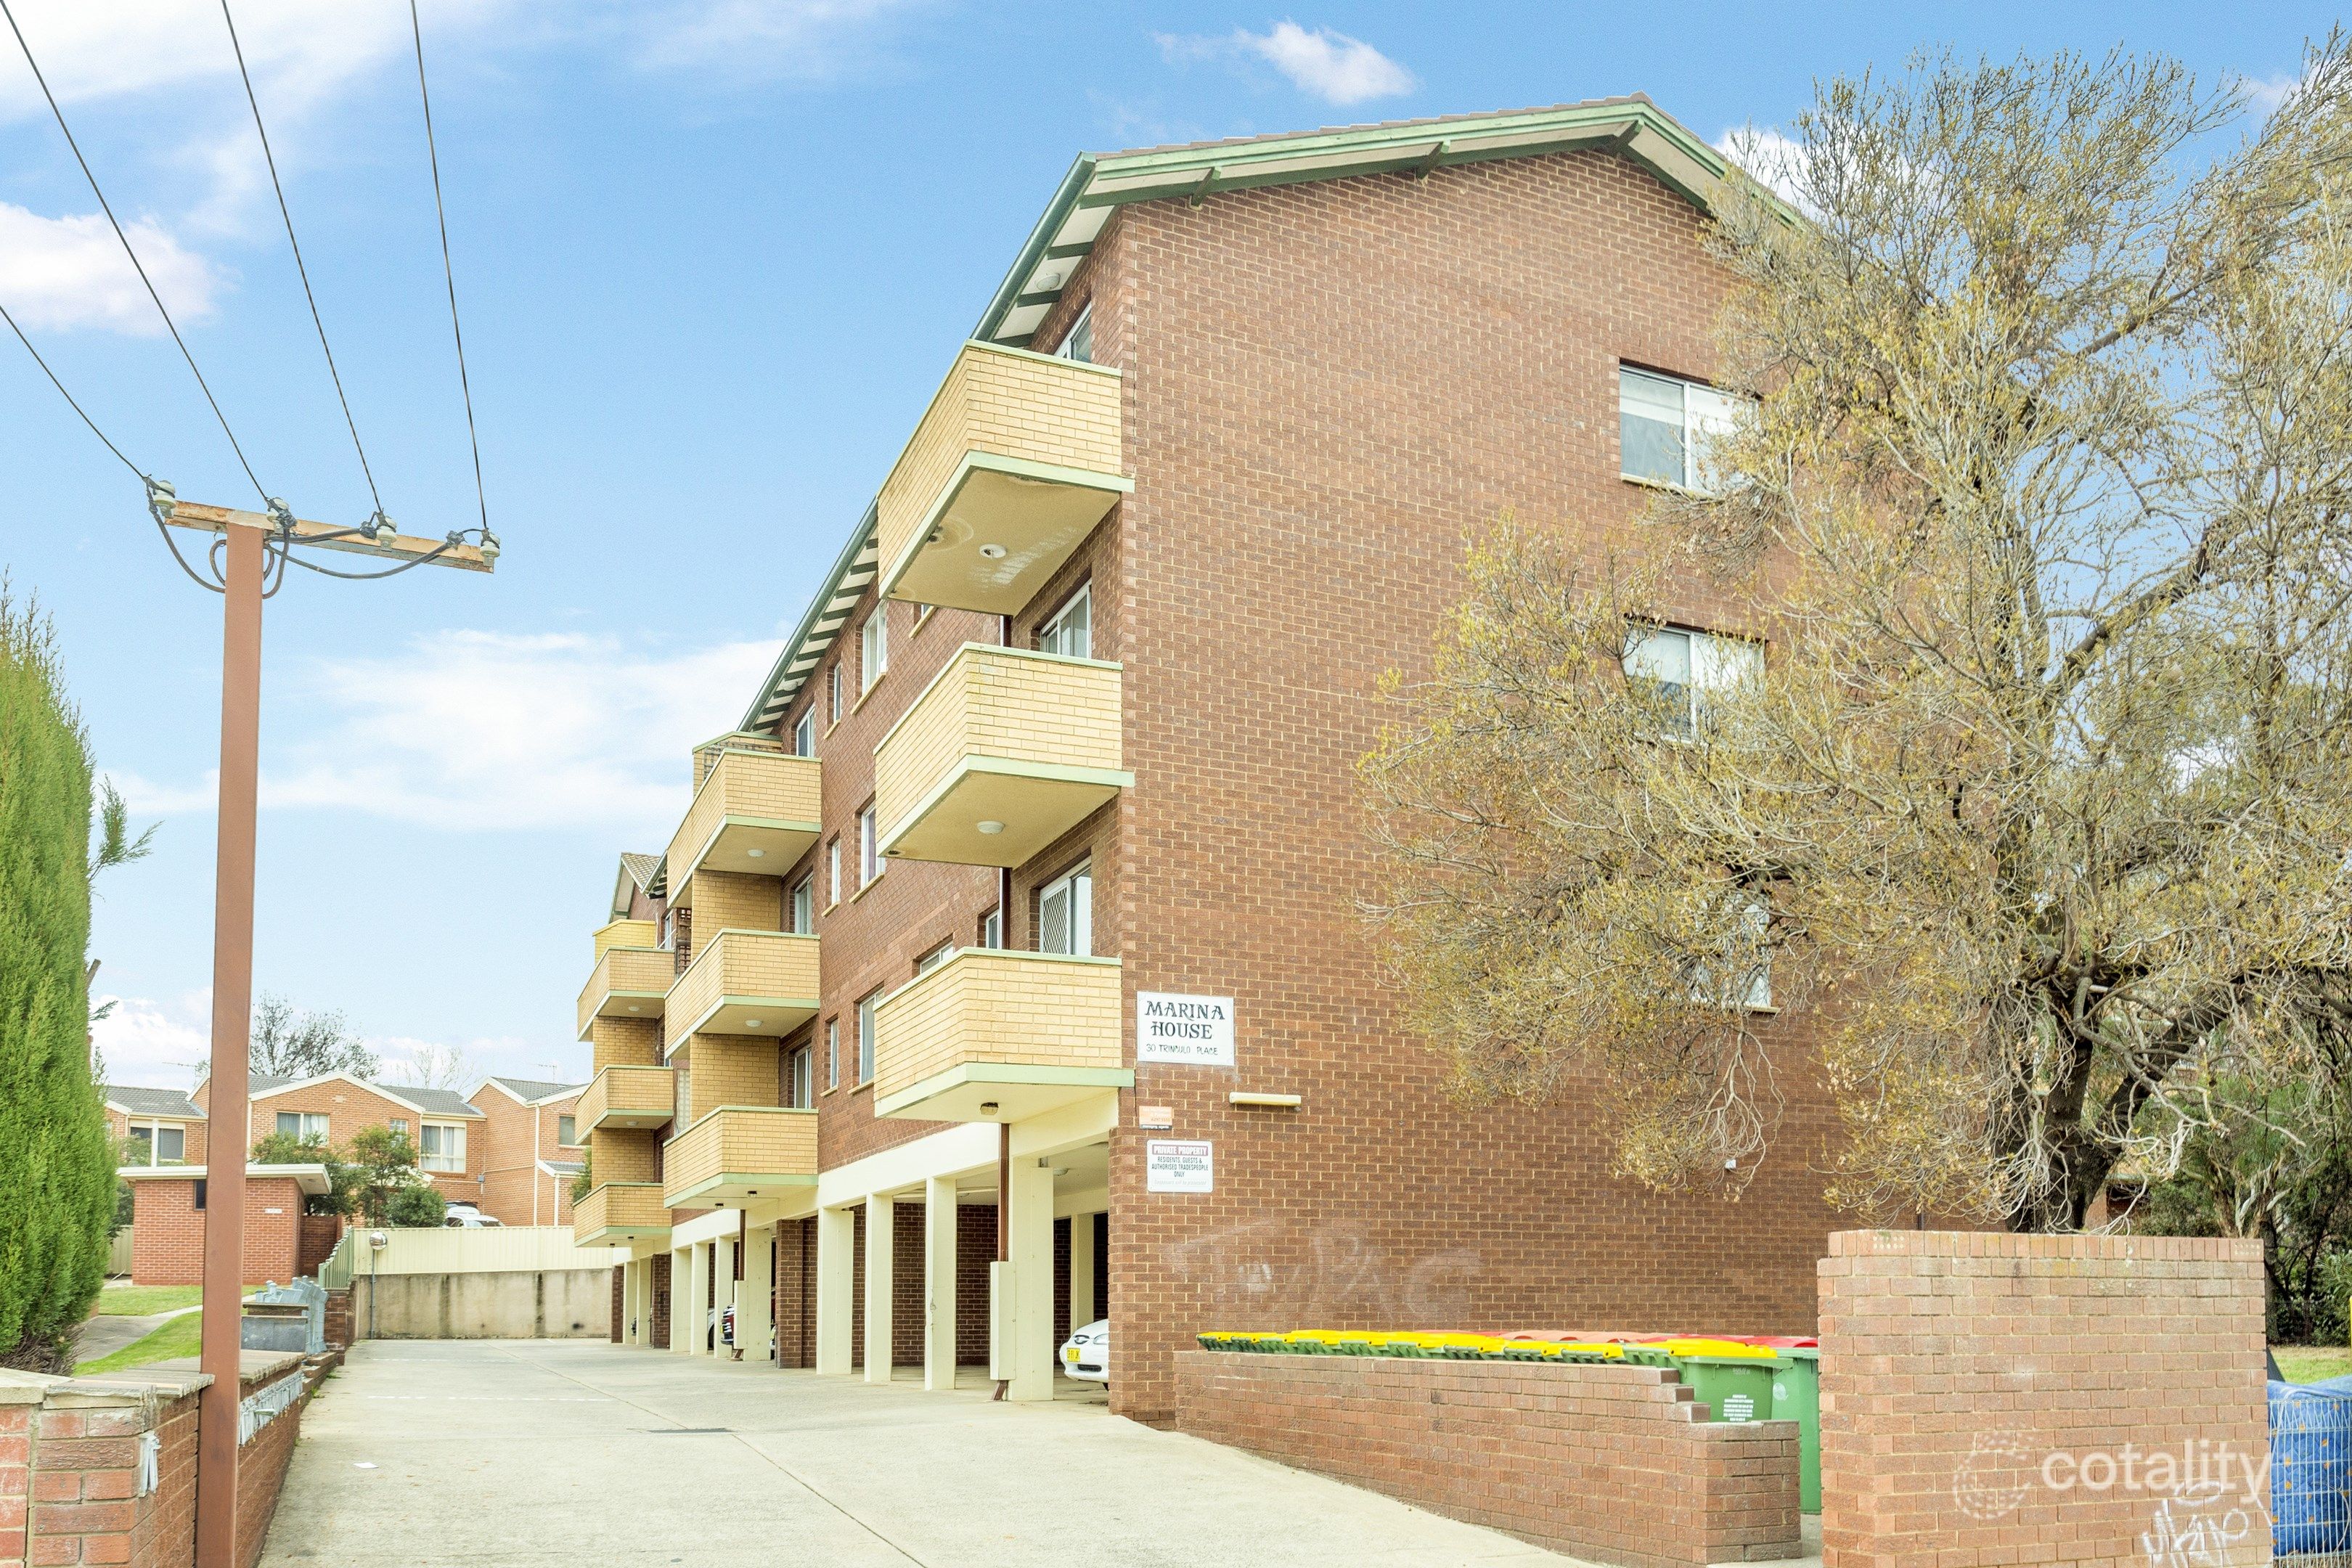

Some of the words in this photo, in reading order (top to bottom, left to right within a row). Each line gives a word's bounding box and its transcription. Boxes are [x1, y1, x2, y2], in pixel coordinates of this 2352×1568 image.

[1145, 1001, 1225, 1021] MARINA
[1151, 1021, 1212, 1039] HOUSE
[1197, 1047, 1218, 1055] PLACE
[1153, 1146, 1177, 1155] PRIVATE
[1178, 1146, 1207, 1156] PROPERTY
